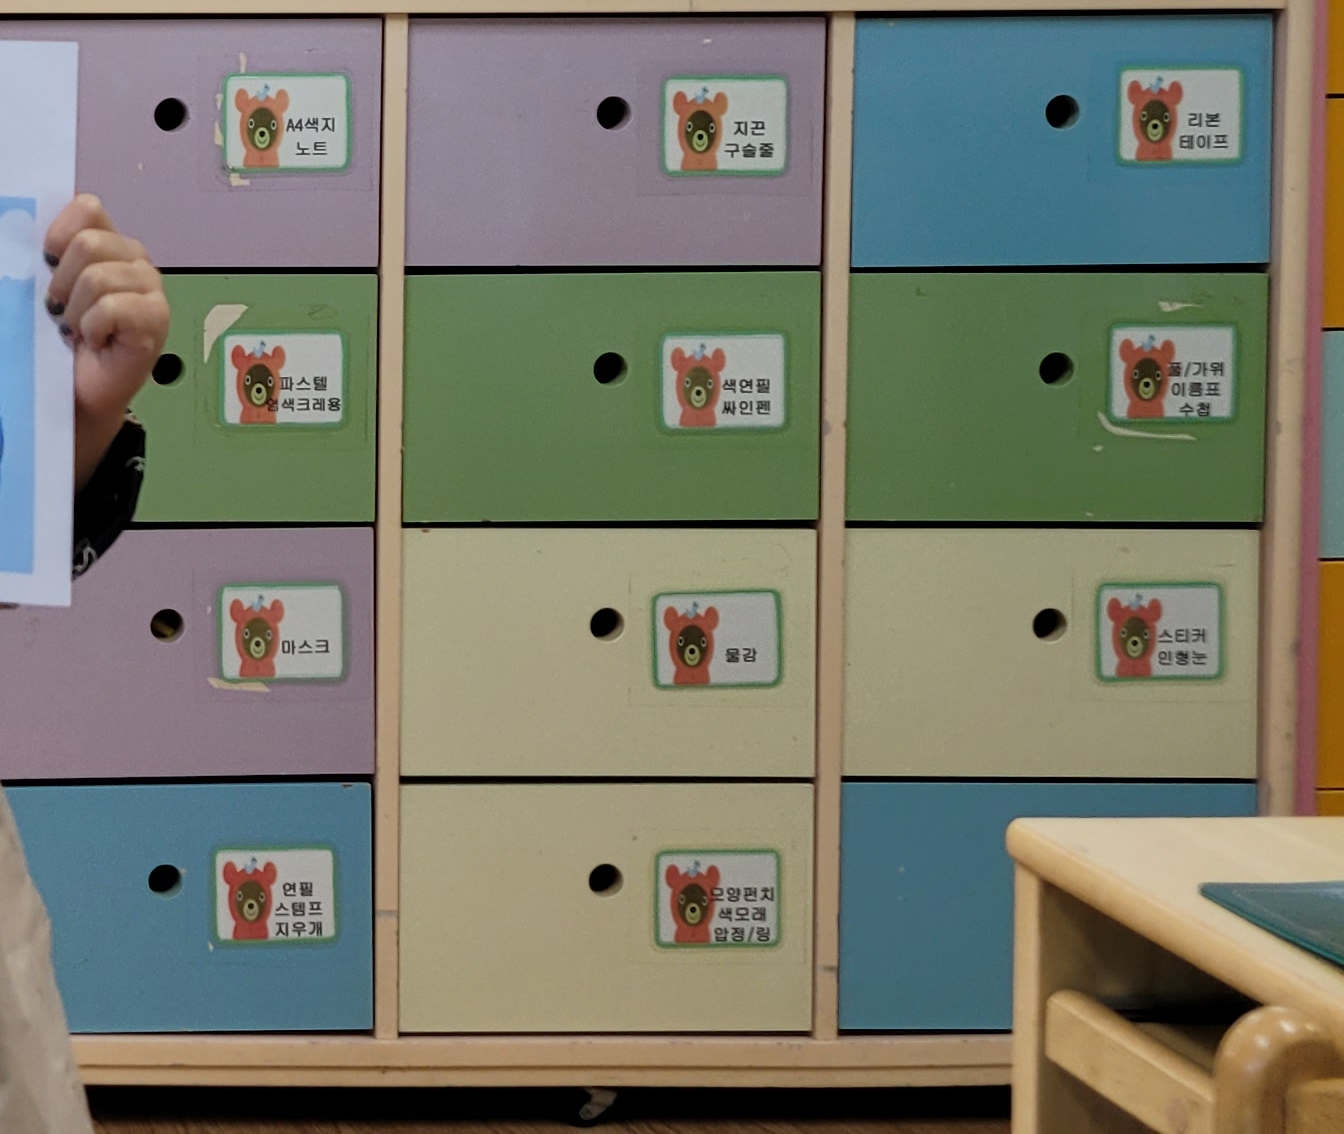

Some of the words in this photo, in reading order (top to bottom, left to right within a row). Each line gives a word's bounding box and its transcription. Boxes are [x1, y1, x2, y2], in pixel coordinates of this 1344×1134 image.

[285, 117, 336, 134] A4색지
[1188, 112, 1220, 128] 리본
[734, 121, 766, 137] 지끈
[296, 141, 327, 157] 노트
[1179, 133, 1229, 150] 테이프
[724, 142, 774, 159] 구슬줄
[1168, 361, 1224, 377] 풀/가위
[280, 376, 327, 392] 파스텔
[723, 379, 770, 395] 색연필
[1172, 382, 1221, 397] 이름표
[722, 398, 770, 415] 싸인펜
[1179, 402, 1210, 417] 수첩
[1158, 628, 1207, 644] 스티커
[281, 640, 330, 655] 마스크
[725, 647, 757, 664] 물감
[1158, 649, 1207, 666] 인형눈
[282, 881, 314, 897] 연필
[710, 887, 775, 903] 모양펀치
[275, 900, 323, 917] 스템프
[718, 907, 767, 923] 색모래
[274, 920, 323, 937] 지우개
[714, 926, 771, 942] 압정/링
